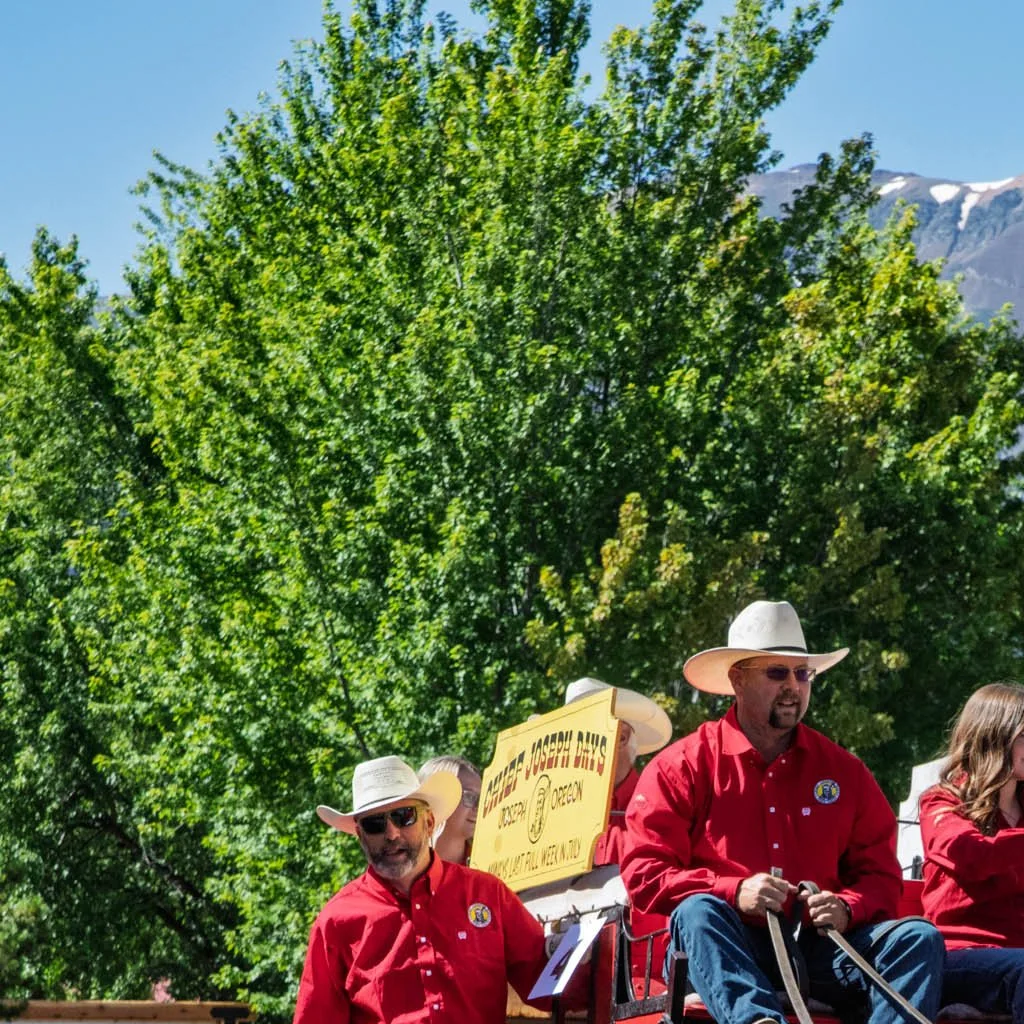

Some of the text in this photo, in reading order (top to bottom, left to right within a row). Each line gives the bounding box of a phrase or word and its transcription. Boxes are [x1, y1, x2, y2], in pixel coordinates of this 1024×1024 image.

[483, 730, 607, 818] CHIEF JOSEPH DAYS
[498, 780, 584, 829] JOSEPH OREGON
[541, 844, 559, 867] WEEK
